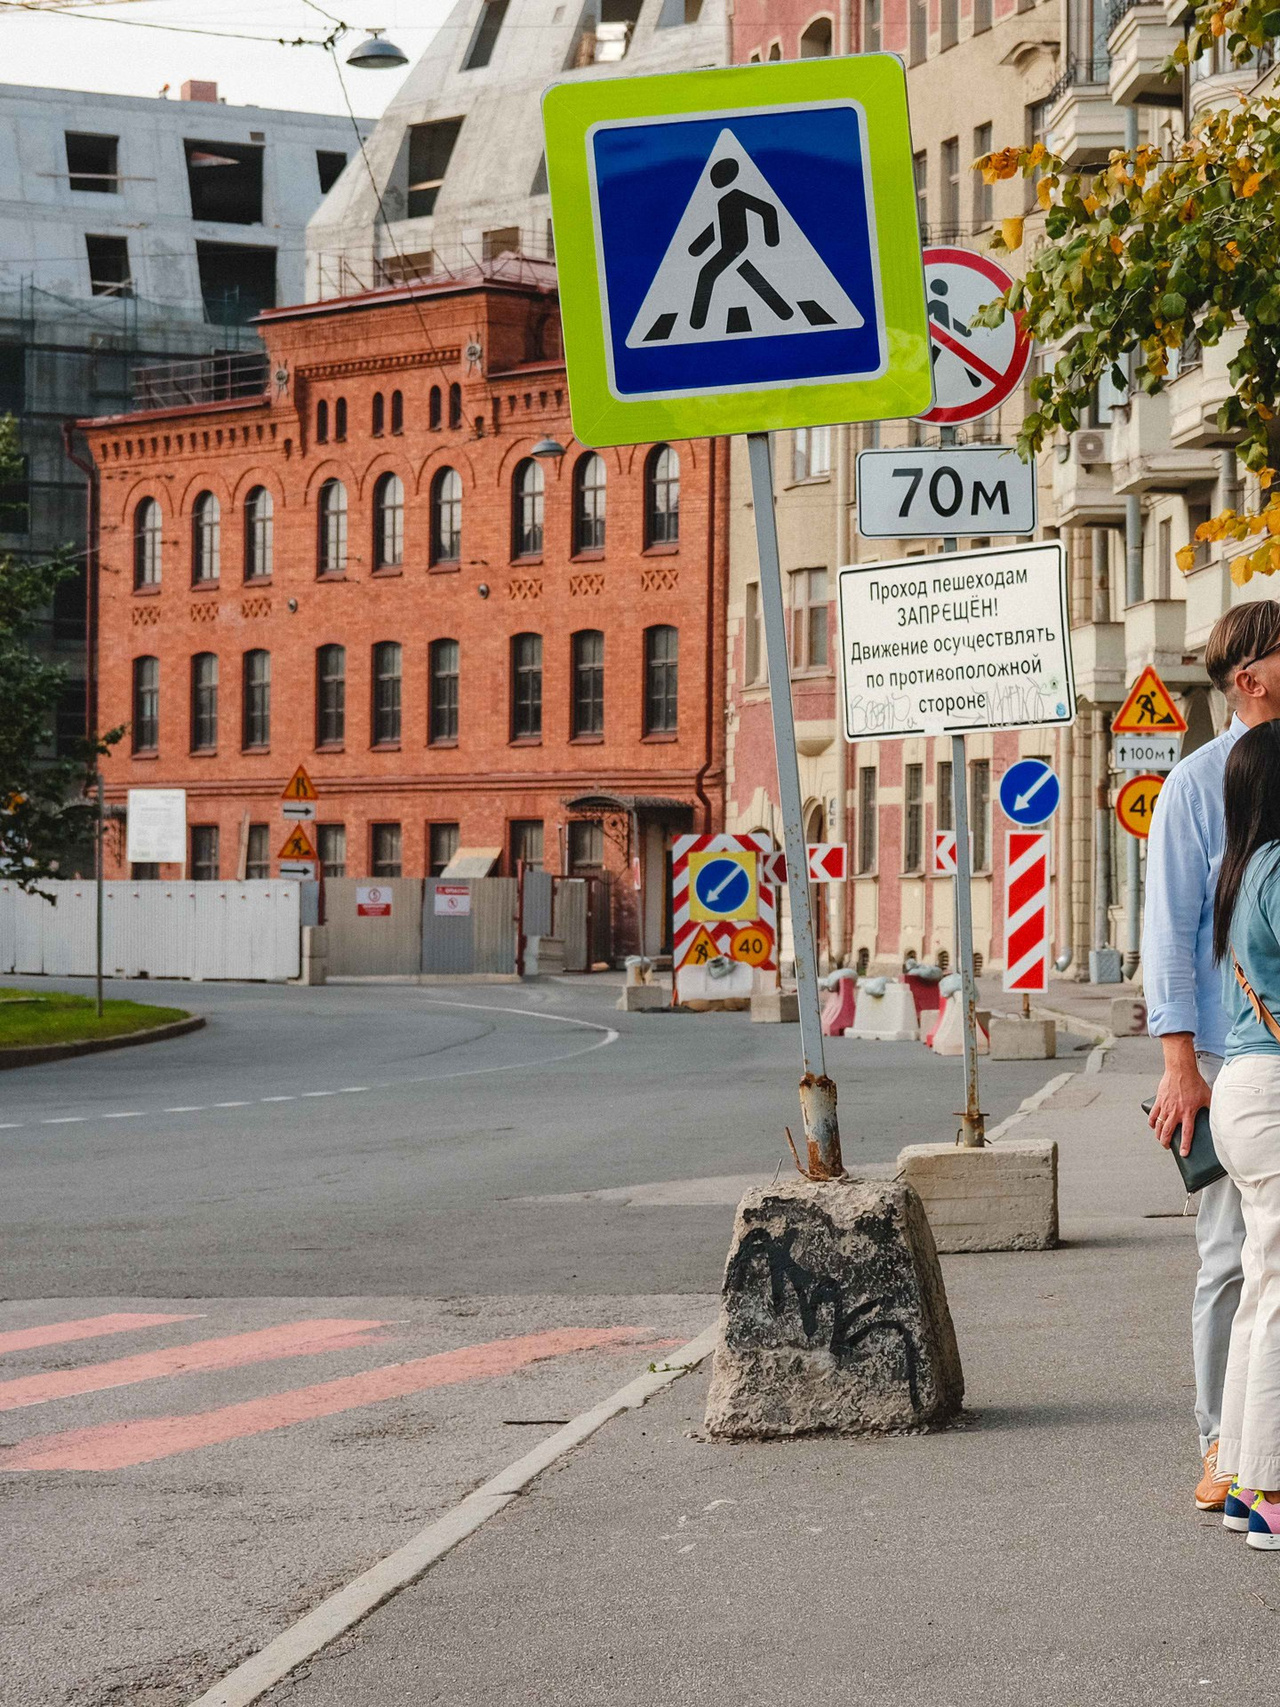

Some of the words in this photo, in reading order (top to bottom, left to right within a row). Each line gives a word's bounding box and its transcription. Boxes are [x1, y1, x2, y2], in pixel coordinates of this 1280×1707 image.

[892, 466, 1010, 518] 70м
[870, 580, 927, 604] Проход
[933, 568, 1028, 594] пешеходам
[897, 595, 999, 627] ЗАПРЕЩЁН!
[851, 638, 929, 665] Движение
[933, 627, 1056, 656] осуществлять
[866, 672, 884, 688] по
[889, 653, 1042, 690] противоположной
[919, 693, 986, 716] стороне
[739, 938, 763, 954] 40
